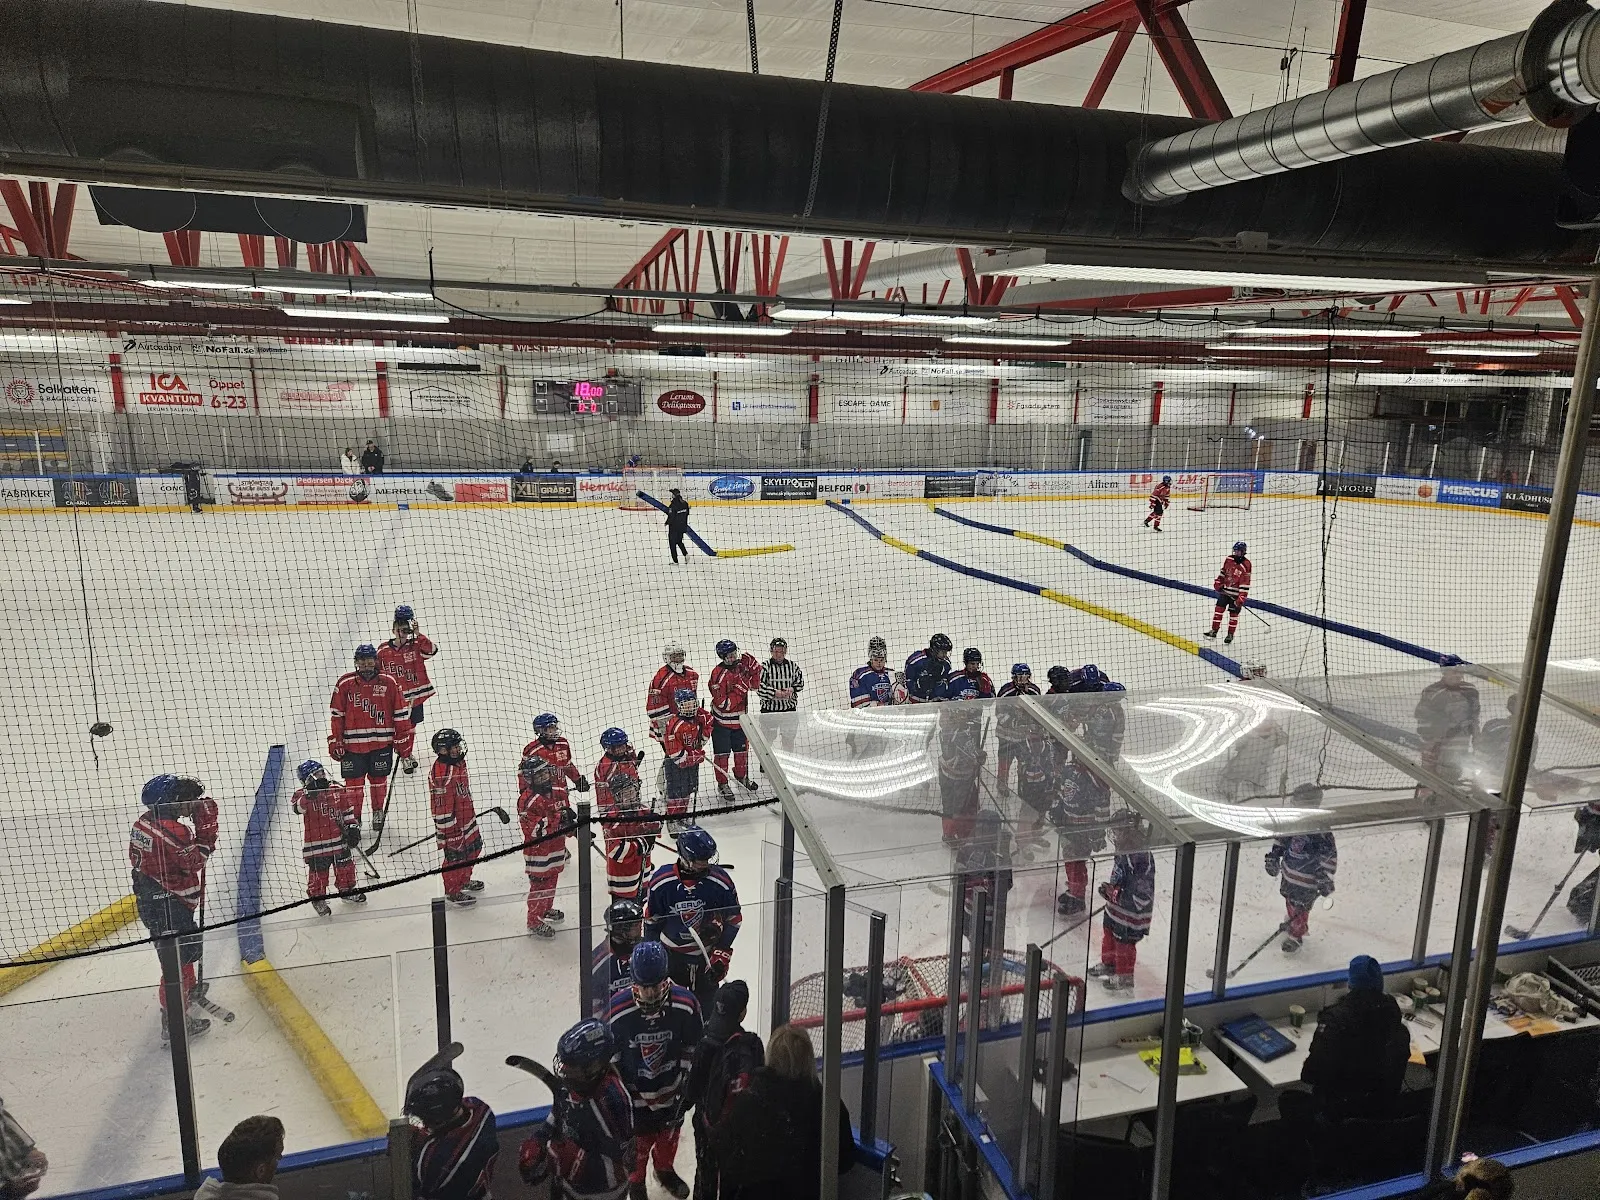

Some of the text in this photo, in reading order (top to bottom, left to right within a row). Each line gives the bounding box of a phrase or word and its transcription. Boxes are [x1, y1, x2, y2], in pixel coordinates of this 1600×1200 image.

[205, 345, 254, 354] NoFall.se
[150, 373, 188, 391] ICA
[209, 378, 245, 390] Öppet
[38, 384, 96, 395] Solkatten
[142, 395, 200, 404] KVANTUM
[210, 395, 247, 409] 6-23
[764, 478, 814, 488] SKYLTPOOLEN
[1129, 474, 1153, 484] LP
[1, 490, 50, 498] FABRIKER
[818, 485, 852, 493] BELFOR
[1443, 484, 1499, 498] MERCUS
